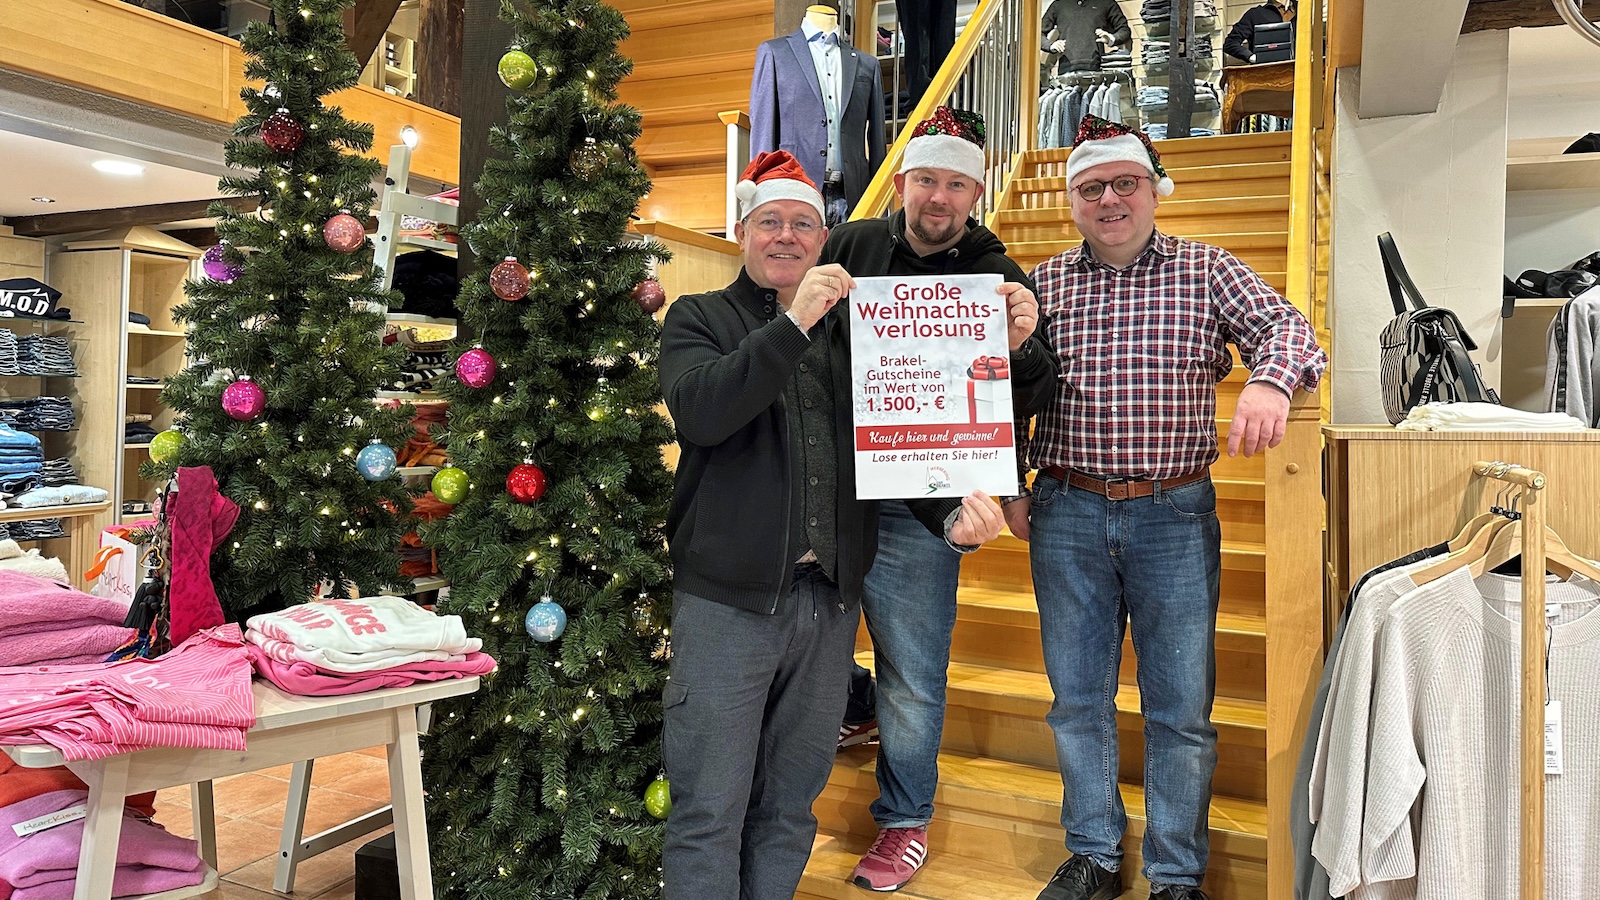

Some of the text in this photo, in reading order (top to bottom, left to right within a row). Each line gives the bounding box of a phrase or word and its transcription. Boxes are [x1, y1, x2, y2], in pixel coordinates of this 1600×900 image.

[893, 282, 962, 301] Große
[856, 300, 999, 321] Weihnachts-
[873, 319, 986, 341] verlosung
[880, 354, 927, 367] Brakel-
[866, 368, 942, 381] Gutscheine
[863, 382, 945, 394] im Wert von
[866, 395, 945, 413] 1.500,- €
[869, 427, 1000, 447] Kaufe hier und gewinne!
[872, 449, 999, 463] Lose erhalten Sie hier!
